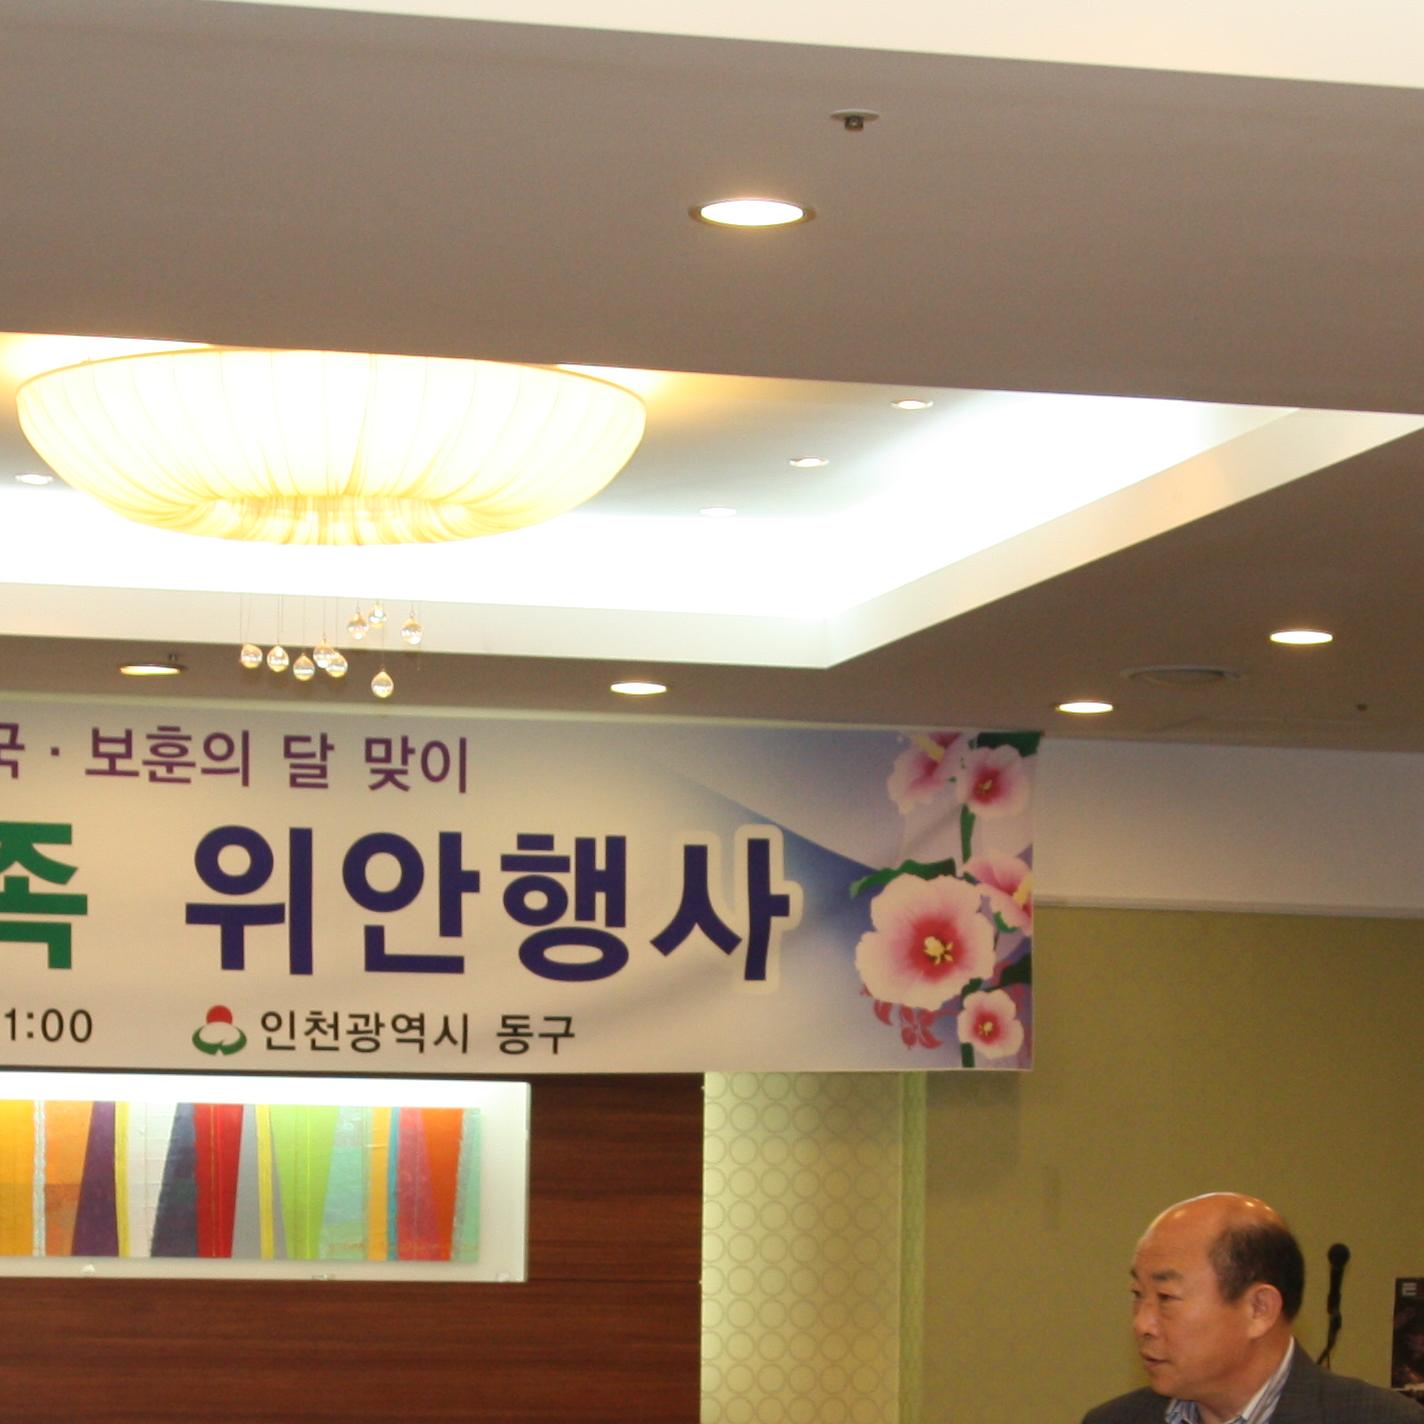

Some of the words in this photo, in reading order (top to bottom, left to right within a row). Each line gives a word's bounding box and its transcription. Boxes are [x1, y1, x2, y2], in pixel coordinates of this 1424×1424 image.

[283, 732, 335, 789] 달
[364, 734, 467, 794] 맞이
[185, 824, 791, 982] 위안행사
[260, 1010, 469, 1055] 인천광역시
[496, 1014, 576, 1056] 동구
